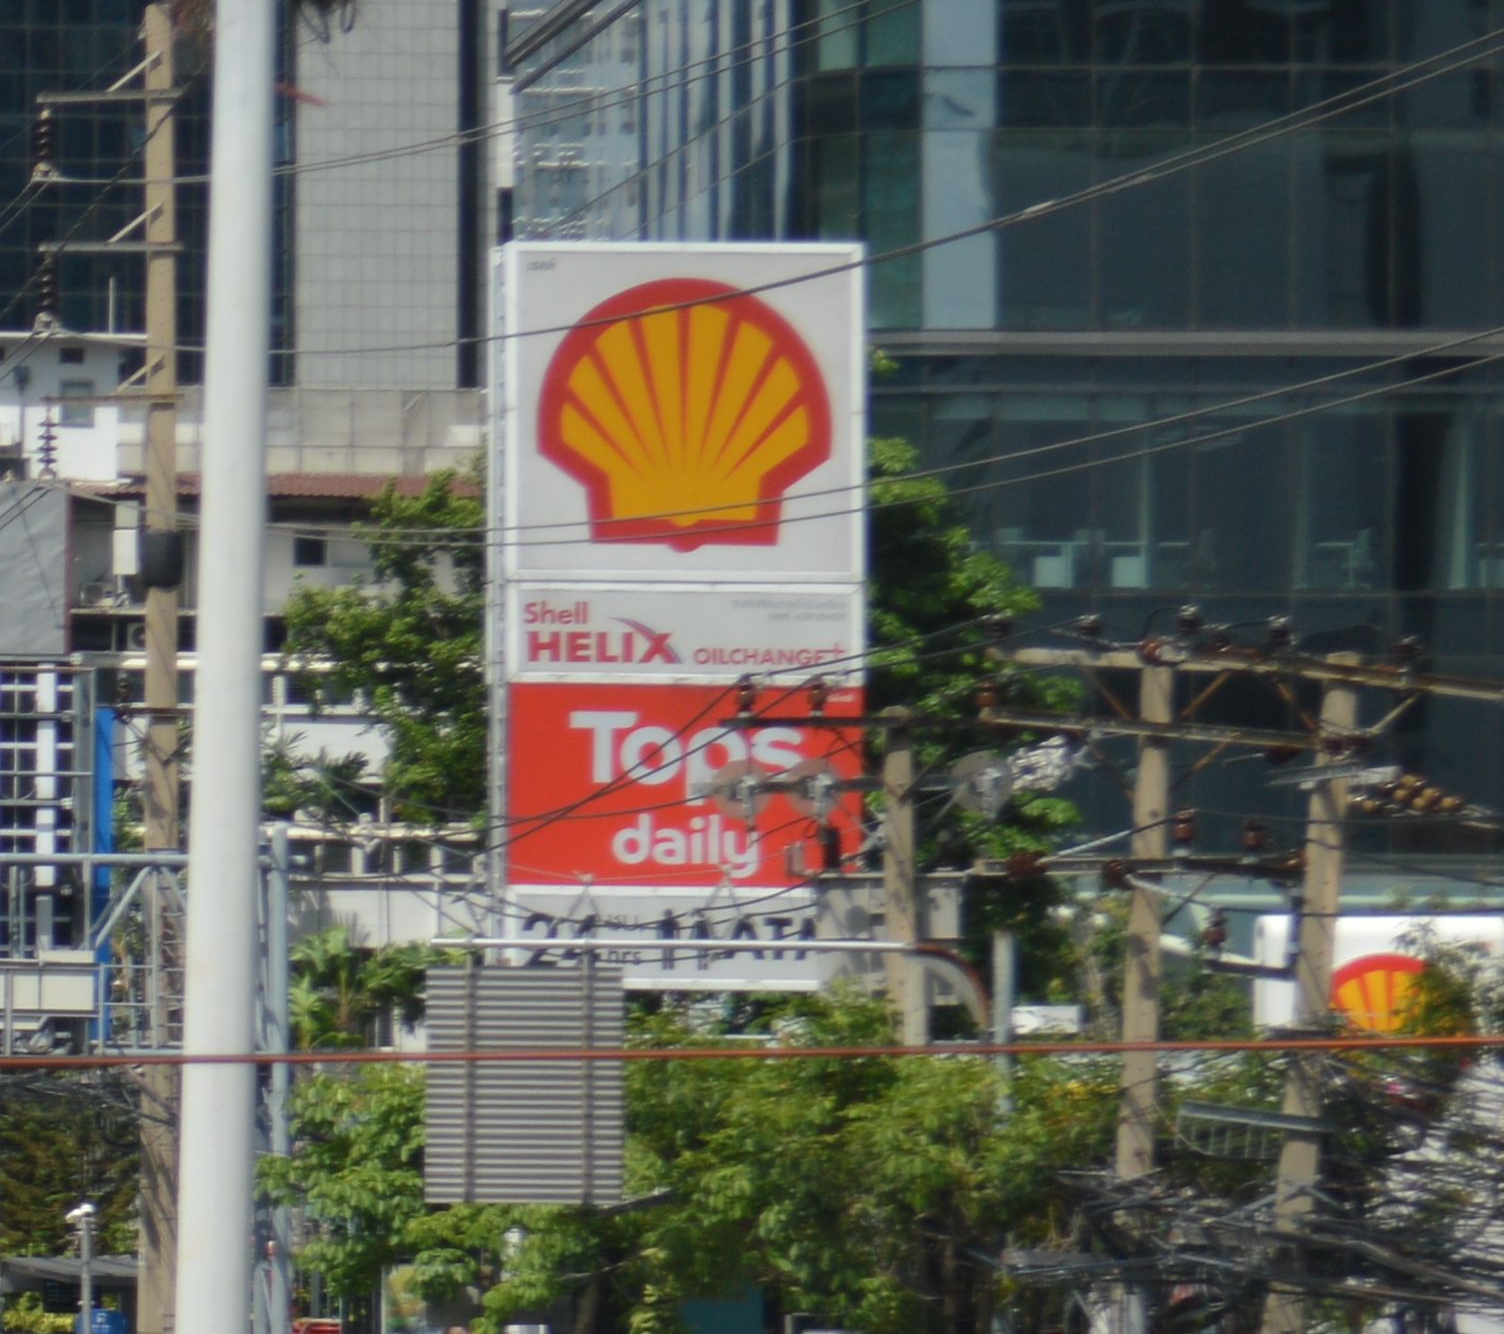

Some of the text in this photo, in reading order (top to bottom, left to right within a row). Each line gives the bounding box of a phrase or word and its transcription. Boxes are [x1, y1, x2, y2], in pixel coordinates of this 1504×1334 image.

[522, 600, 589, 625] Shell
[525, 629, 683, 665] HELIX
[611, 813, 761, 879] daily
